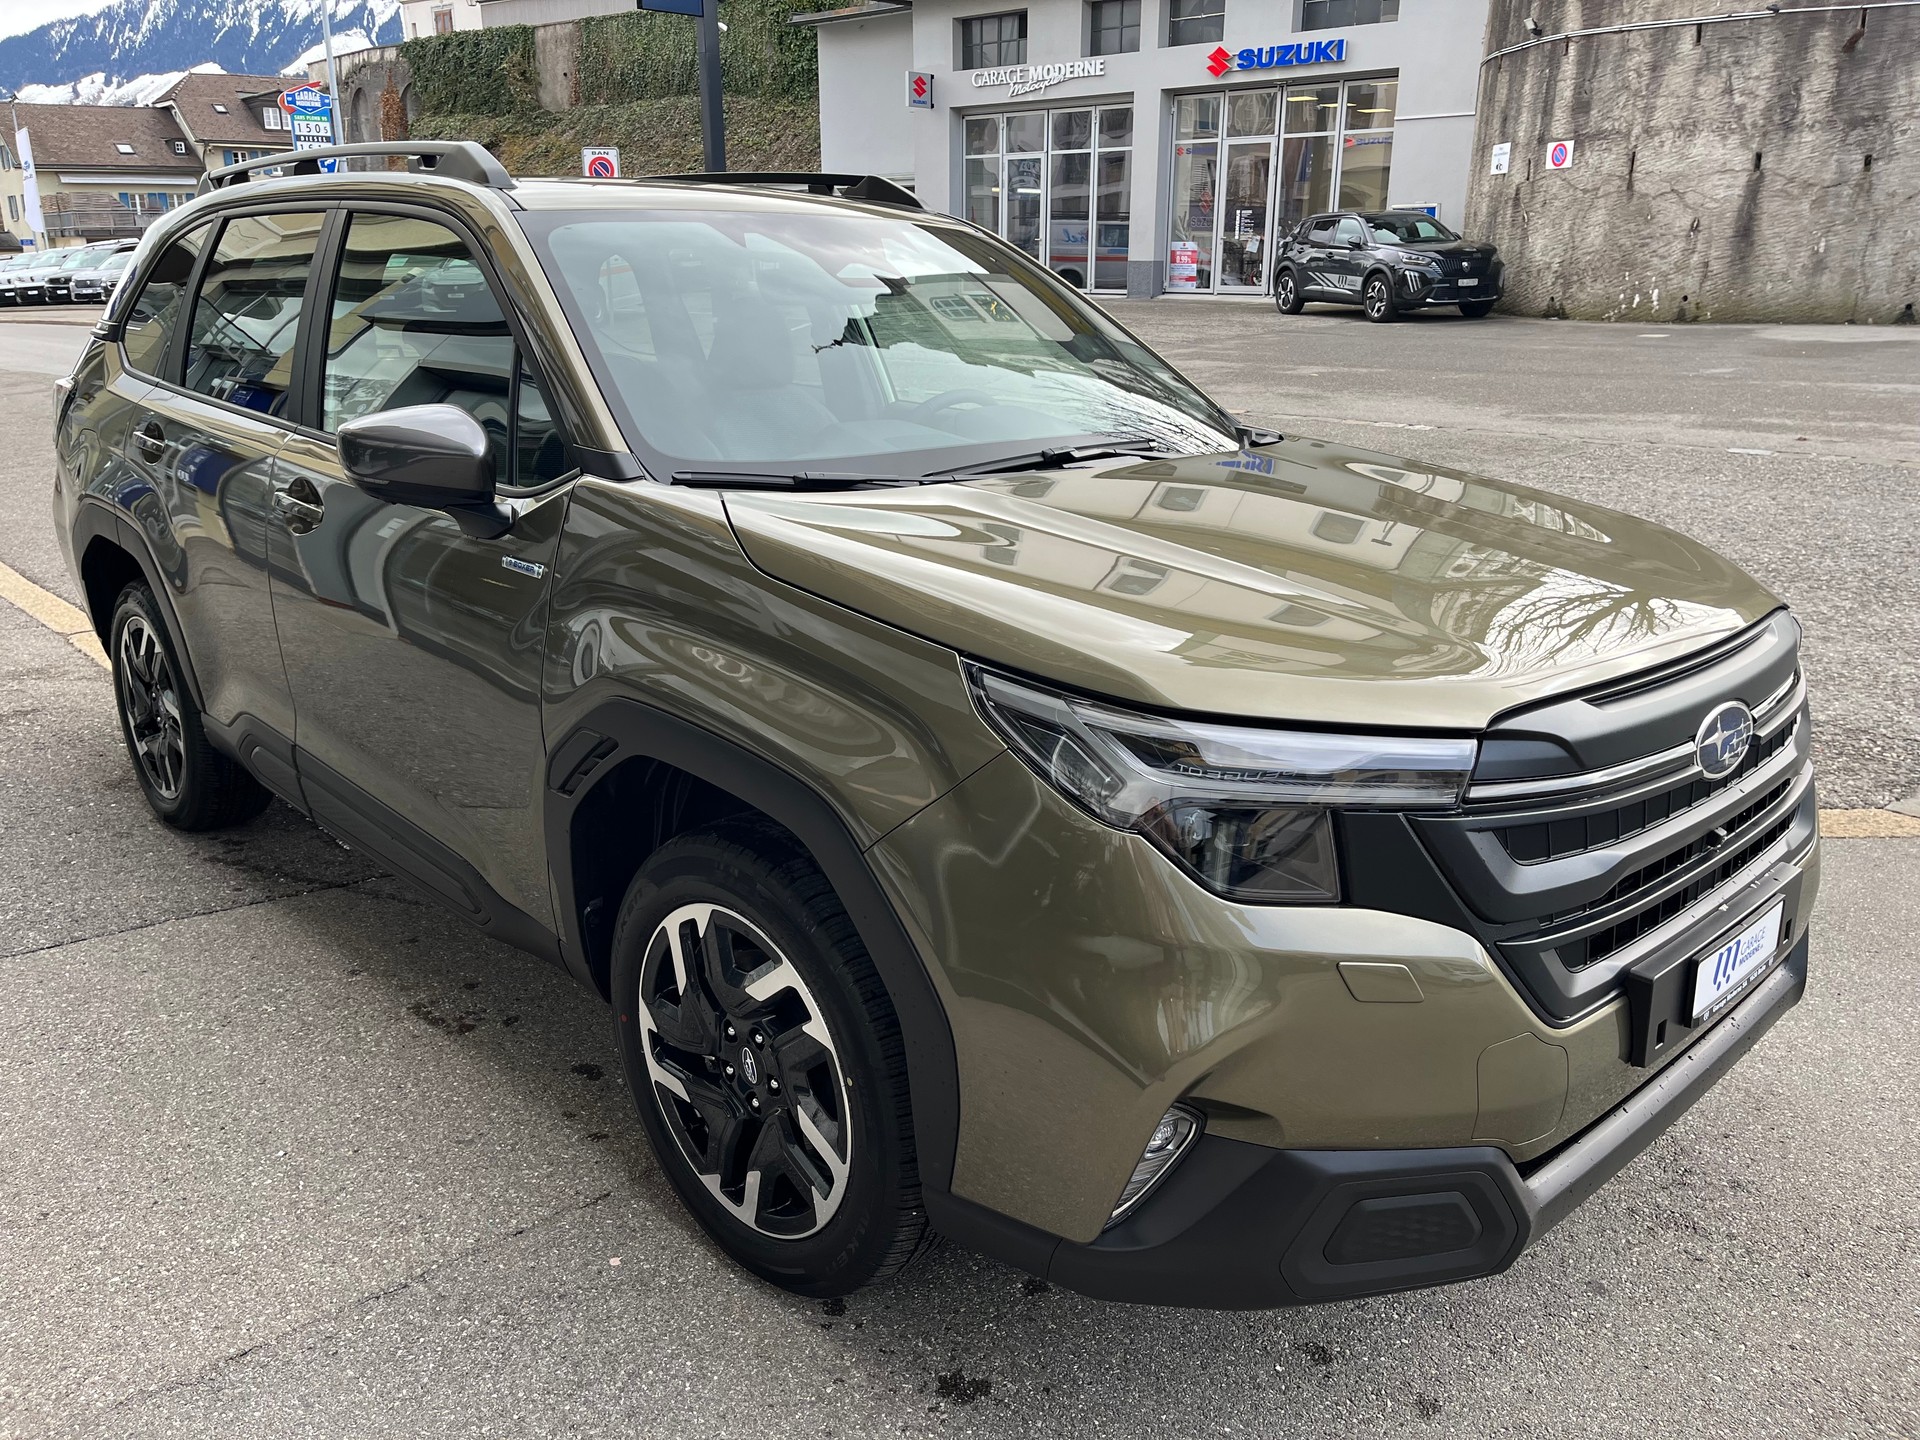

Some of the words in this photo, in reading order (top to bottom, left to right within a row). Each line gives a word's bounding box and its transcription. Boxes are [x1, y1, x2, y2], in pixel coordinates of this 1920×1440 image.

[1236, 38, 1347, 70] SUZUKI
[971, 66, 1025, 87] GARAGE
[1028, 59, 1106, 82] MODERNE
[295, 91, 321, 101] GARAGE
